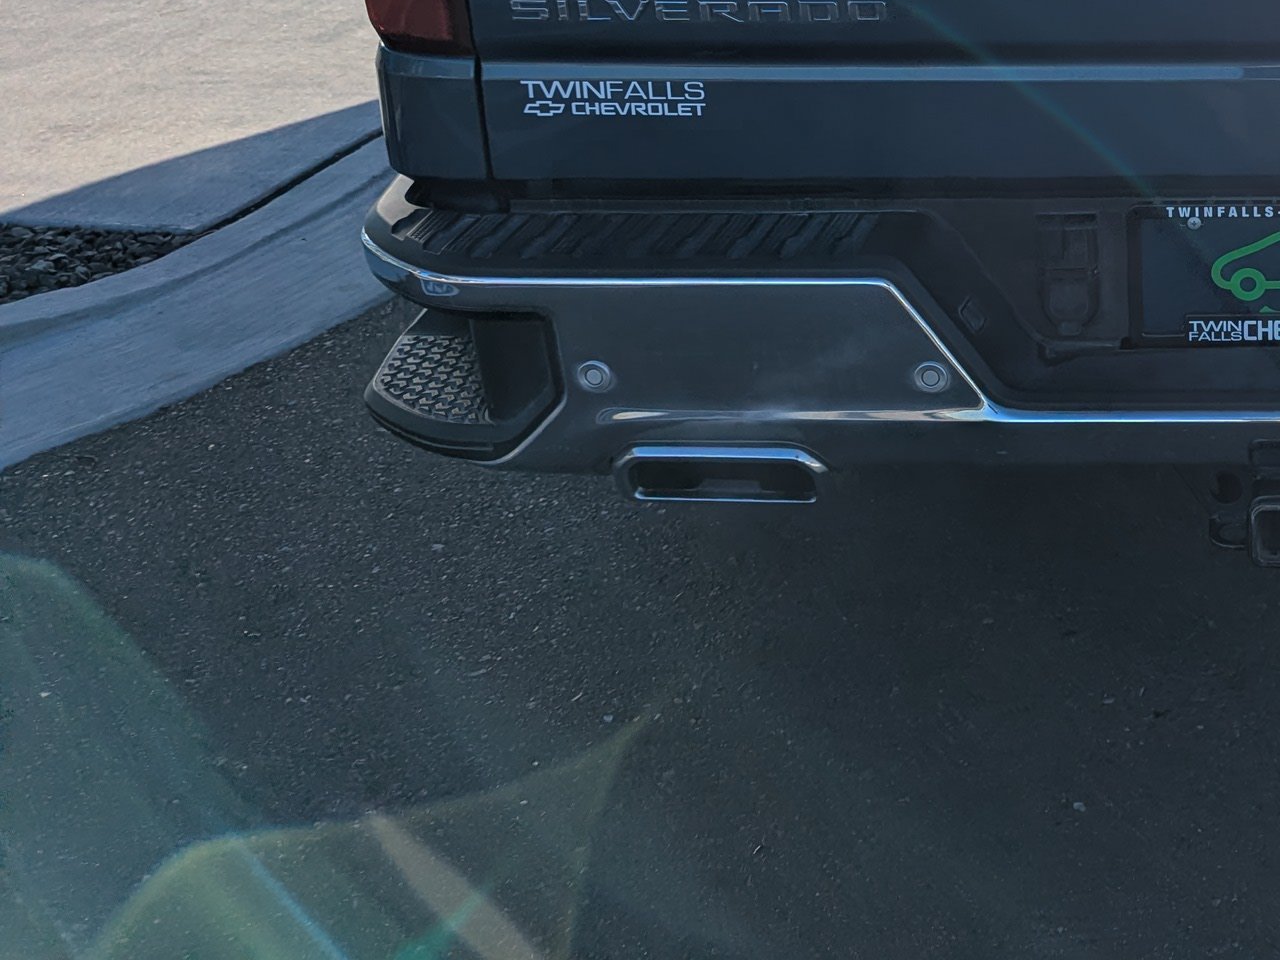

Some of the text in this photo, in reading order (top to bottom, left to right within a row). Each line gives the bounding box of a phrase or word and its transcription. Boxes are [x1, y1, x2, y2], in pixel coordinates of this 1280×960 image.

[571, 102, 706, 117] CHEVROLET
[1188, 320, 1242, 332] TWIN
[1188, 331, 1243, 342] FALLS
